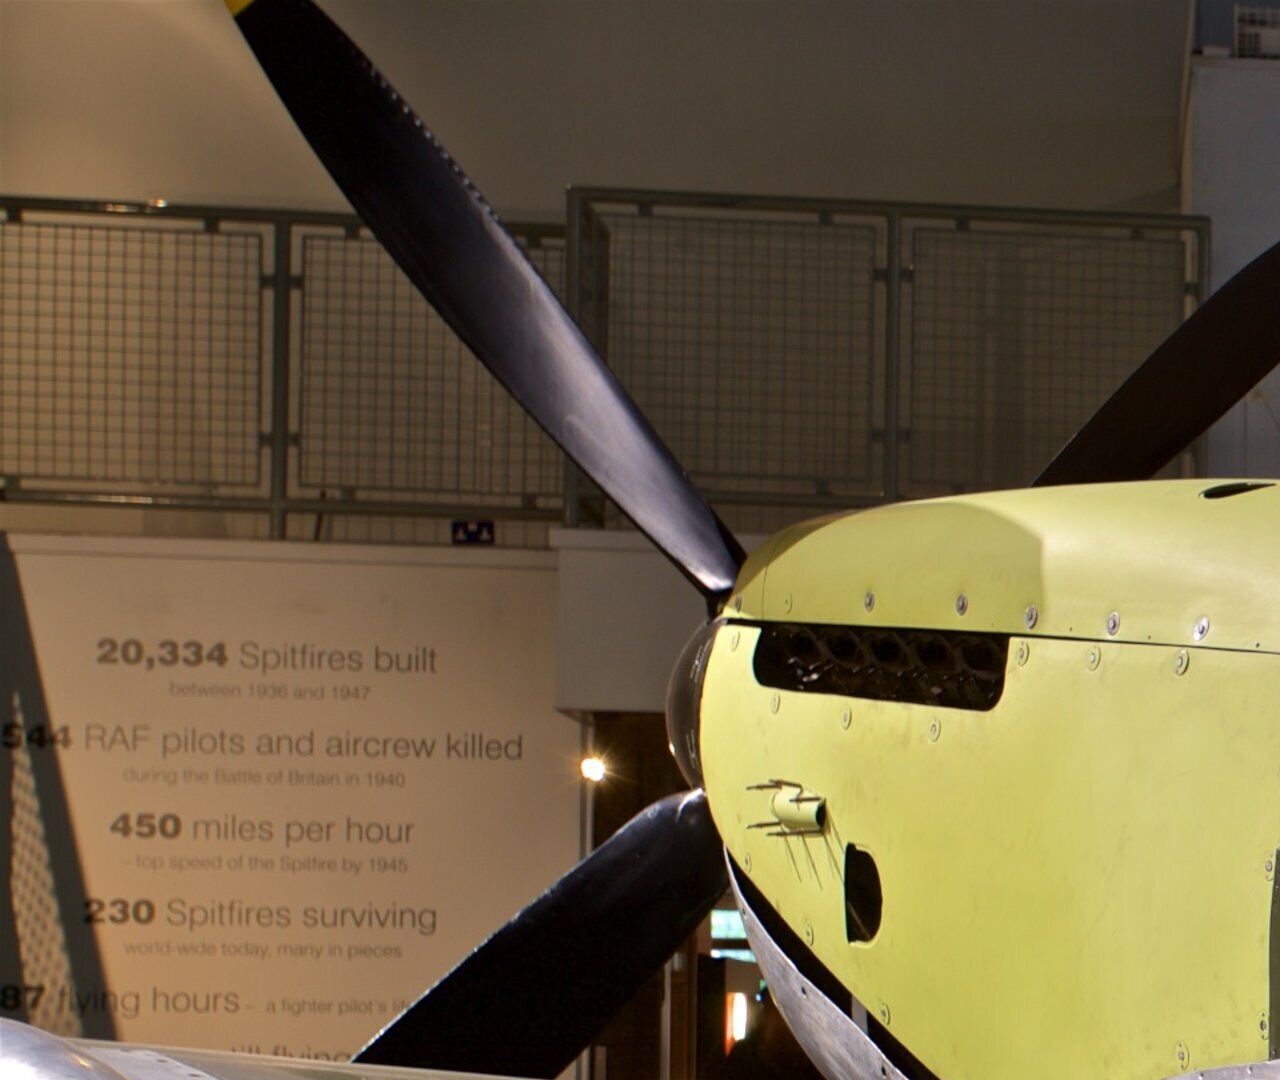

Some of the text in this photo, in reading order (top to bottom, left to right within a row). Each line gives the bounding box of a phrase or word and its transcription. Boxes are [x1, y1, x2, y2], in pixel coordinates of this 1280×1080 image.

[97, 637, 438, 674] 20,334 Spitfires built
[169, 682, 371, 700] between 1936 and 1947
[1, 722, 523, 761] 544 RAF pilots and aircrew killed
[124, 768, 405, 788] during the Battle of Britain in 1940
[109, 811, 415, 848] 450 miles per hour
[135, 855, 164, 871] top
[169, 855, 222, 873] speed
[227, 855, 243, 871] of
[249, 856, 274, 872] the
[279, 855, 337, 874] Spitfire
[342, 857, 363, 876] by
[369, 857, 408, 873] 1945
[83, 898, 437, 937] 230 Spitfires surviving
[277, 944, 323, 962] many
[328, 944, 343, 958] in
[347, 944, 403, 961] pieces
[0, 985, 46, 1011] 87
[57, 985, 140, 1019] flying
[152, 986, 240, 1014] hours
[265, 1001, 276, 1014] a
[282, 998, 332, 1017] fighter
